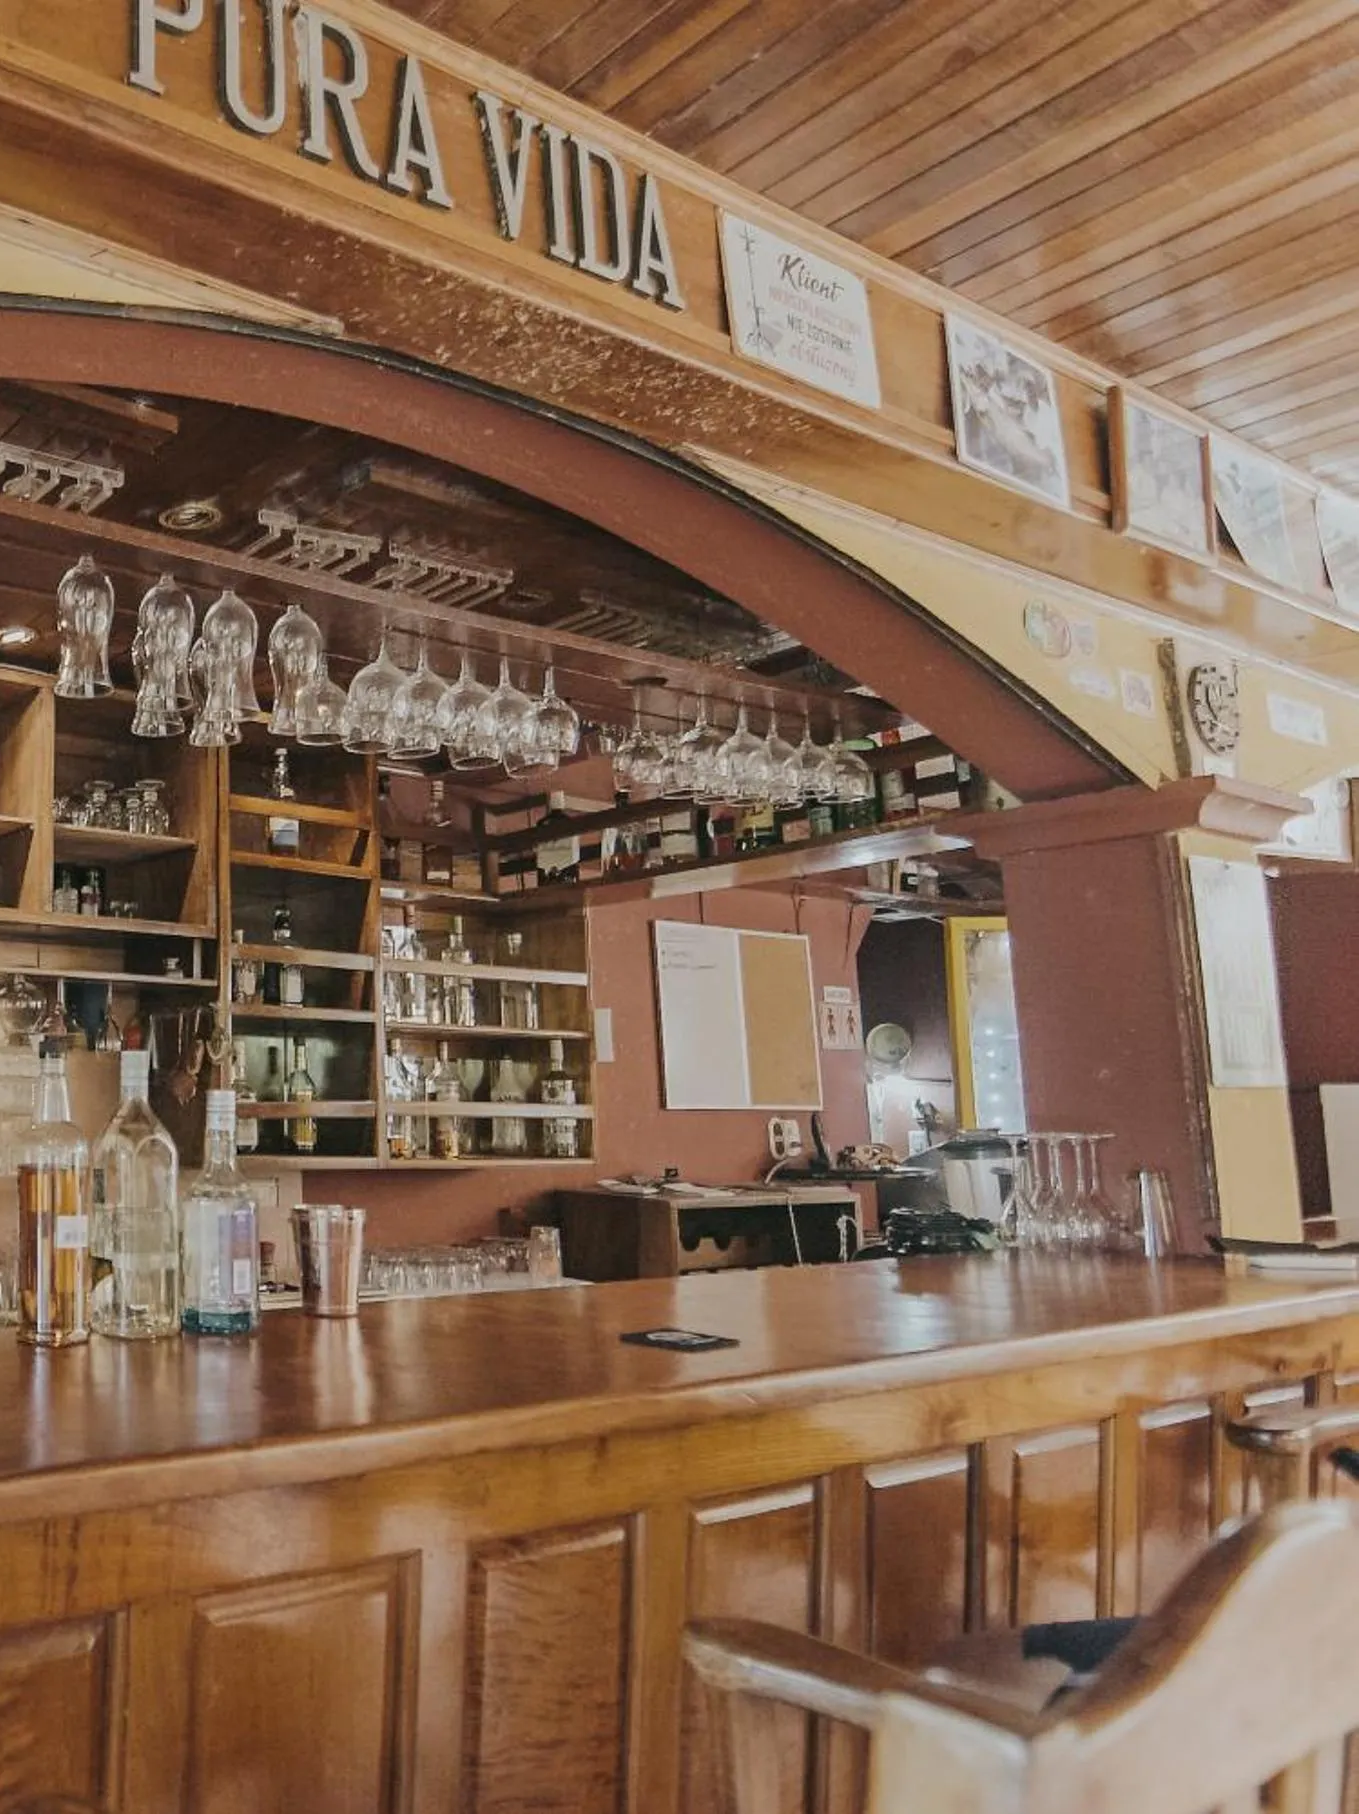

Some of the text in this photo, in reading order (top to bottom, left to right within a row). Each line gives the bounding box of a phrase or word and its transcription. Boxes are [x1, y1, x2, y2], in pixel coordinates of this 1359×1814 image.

[129, 0, 685, 312] PURA VIDA
[778, 254, 845, 302] Klient
